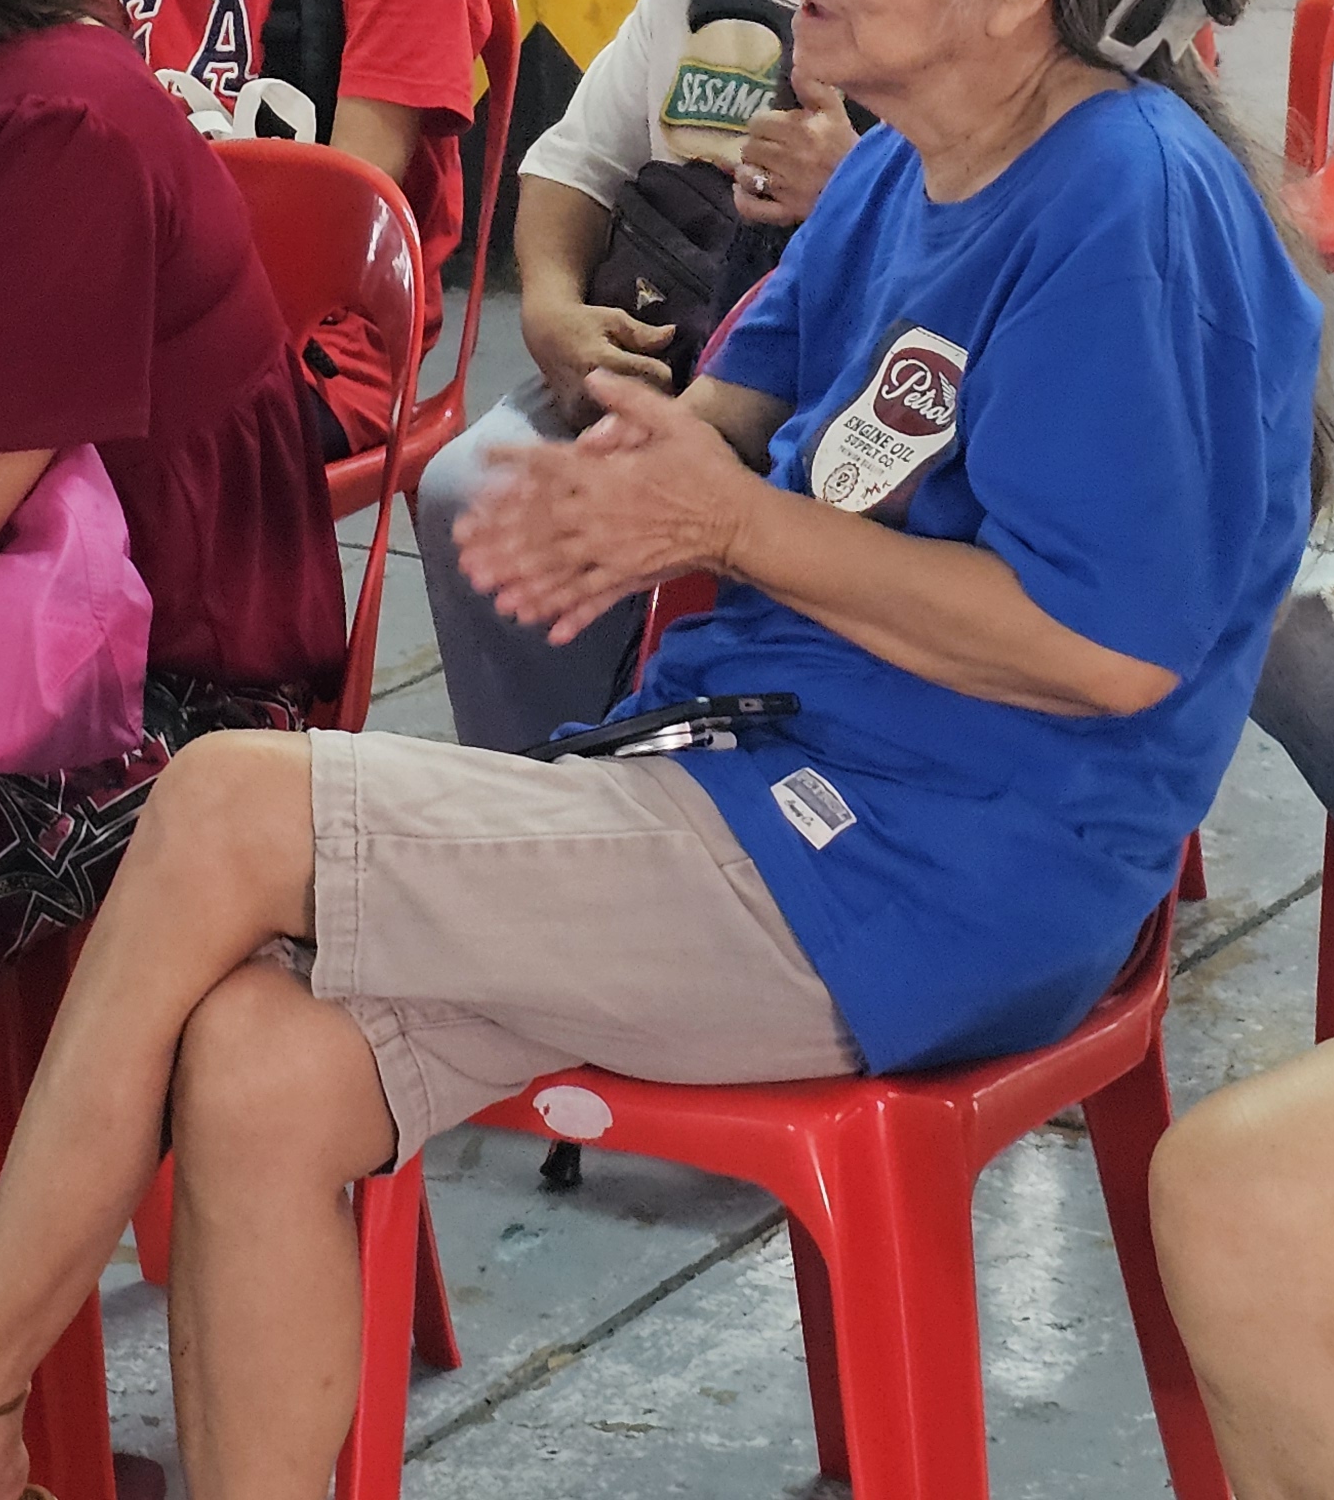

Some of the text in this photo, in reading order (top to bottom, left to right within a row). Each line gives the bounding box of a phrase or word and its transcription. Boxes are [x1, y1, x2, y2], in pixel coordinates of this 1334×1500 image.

[843, 416, 915, 463] ENGINE OIL
[844, 433, 882, 460] SUPPLY
